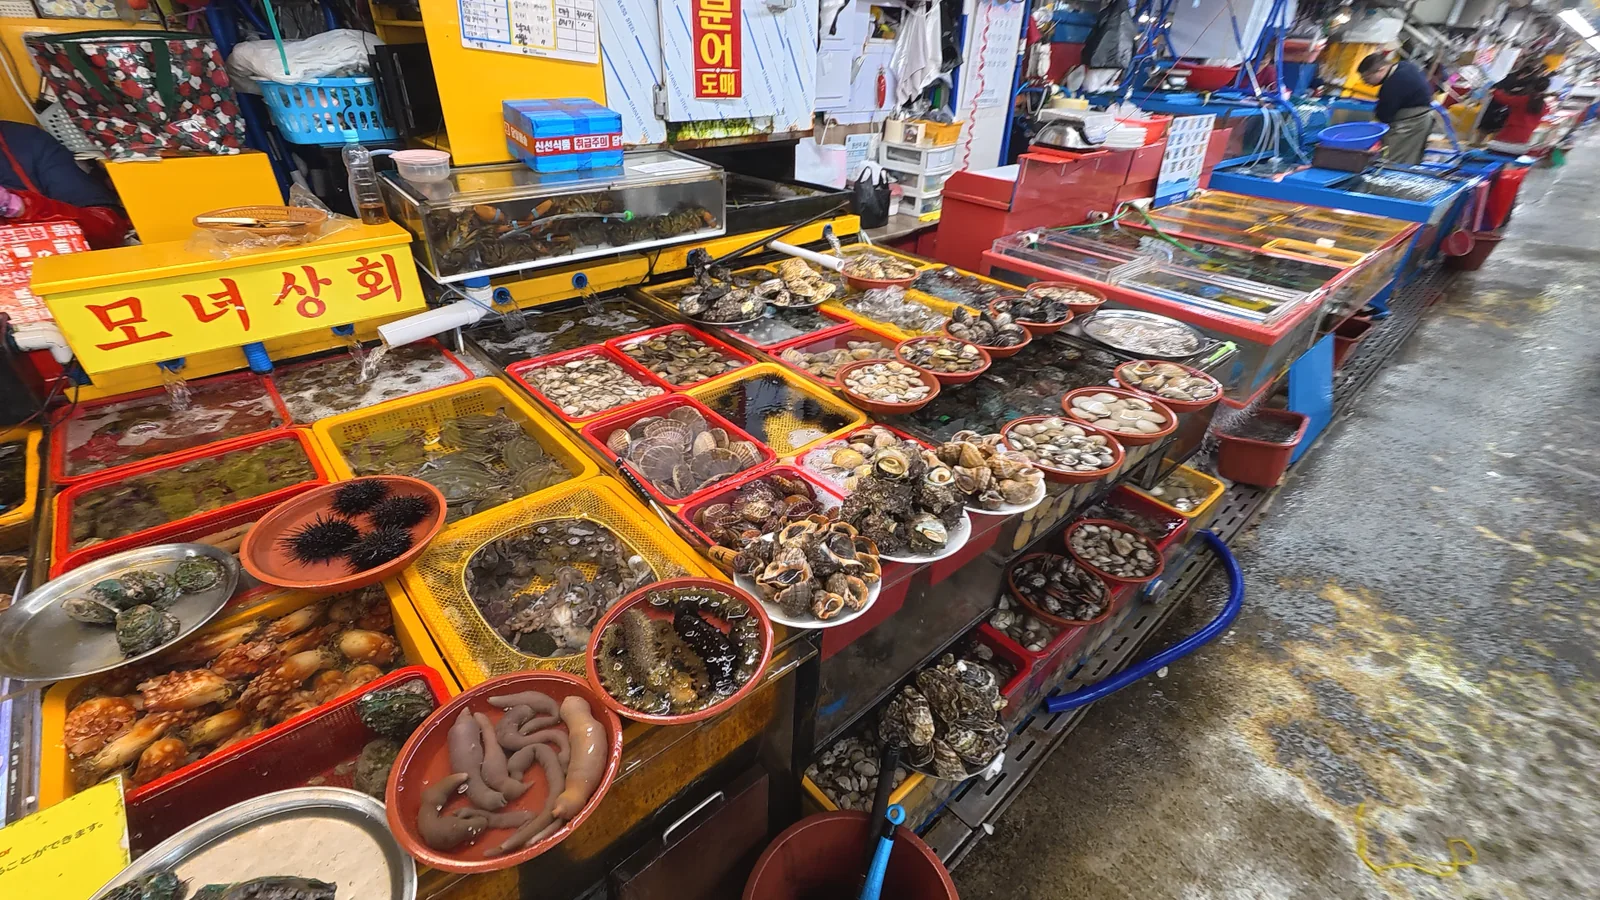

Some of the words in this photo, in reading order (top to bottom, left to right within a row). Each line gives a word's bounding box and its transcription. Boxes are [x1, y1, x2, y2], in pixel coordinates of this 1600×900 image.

[698, 0, 733, 68] 문어
[701, 73, 736, 96] 도매
[535, 139, 571, 153] 신선식품
[575, 136, 608, 149] 취급주의
[85, 253, 402, 351] 모녀상회
